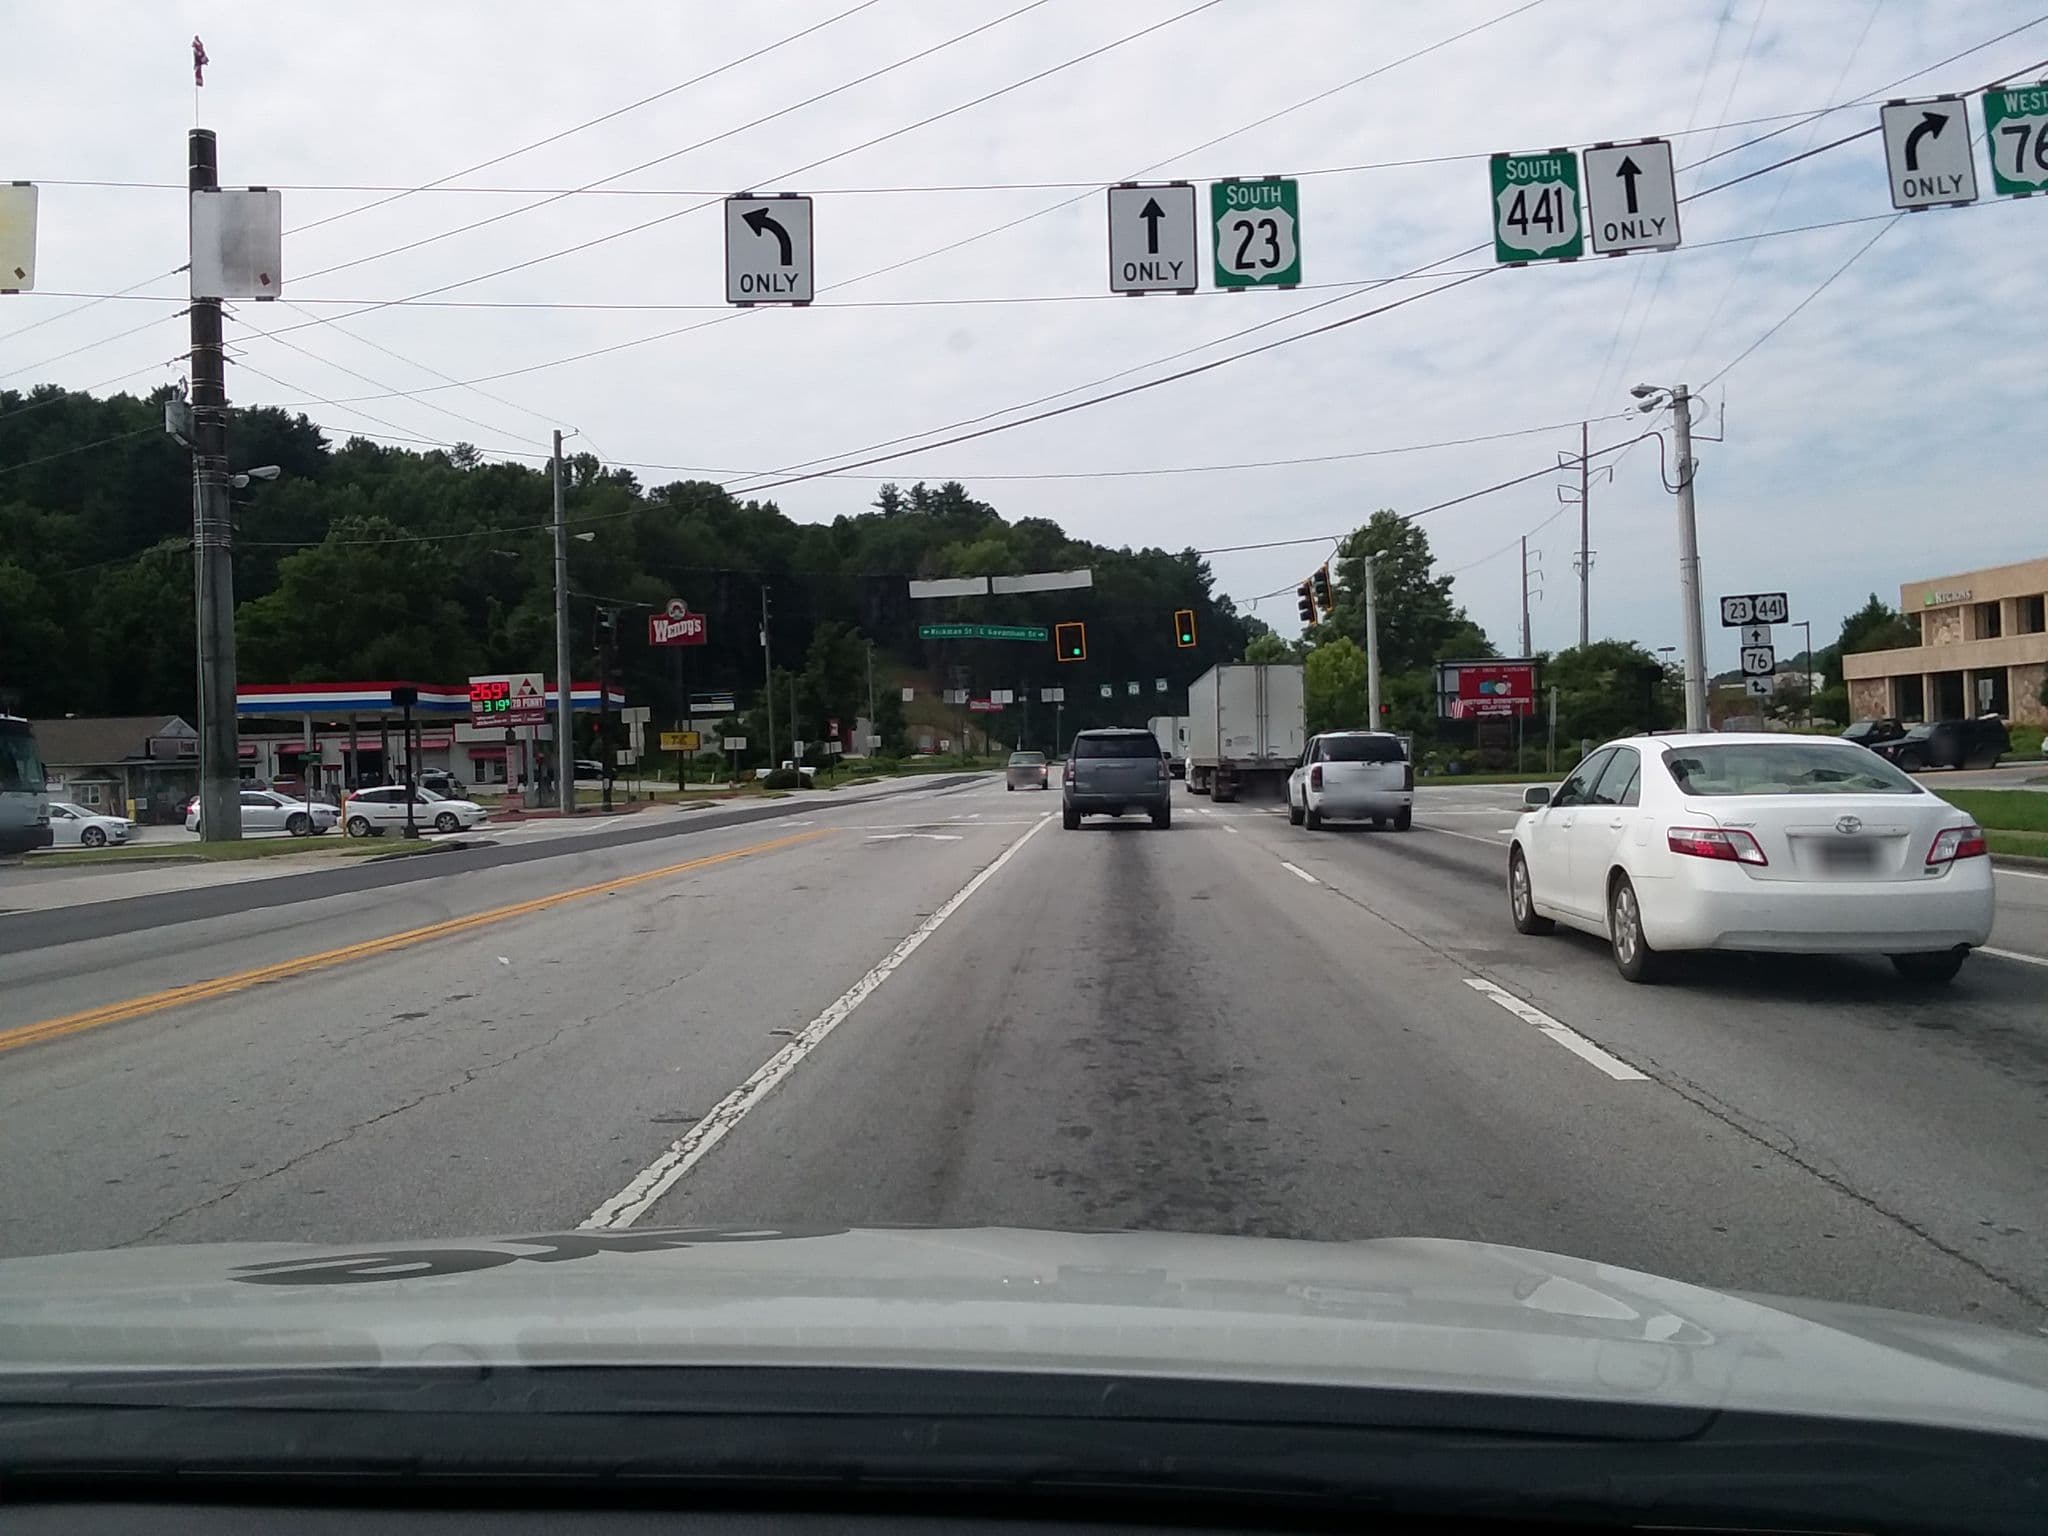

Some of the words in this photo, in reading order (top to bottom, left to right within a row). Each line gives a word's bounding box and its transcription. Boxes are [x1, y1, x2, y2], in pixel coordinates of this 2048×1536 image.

[1506, 159, 1562, 180] SOUTH
[1226, 185, 1281, 205] SOUTH
[1903, 174, 1963, 198] ONLY
[1506, 187, 1564, 236] 441
[1604, 216, 1666, 242] ONLY
[1232, 217, 1281, 270] 23
[1123, 260, 1184, 281] ONLY
[740, 272, 799, 293] ONLY
[1729, 602, 1747, 619] 23
[1758, 600, 1783, 617] 441
[1747, 653, 1768, 669] 76
